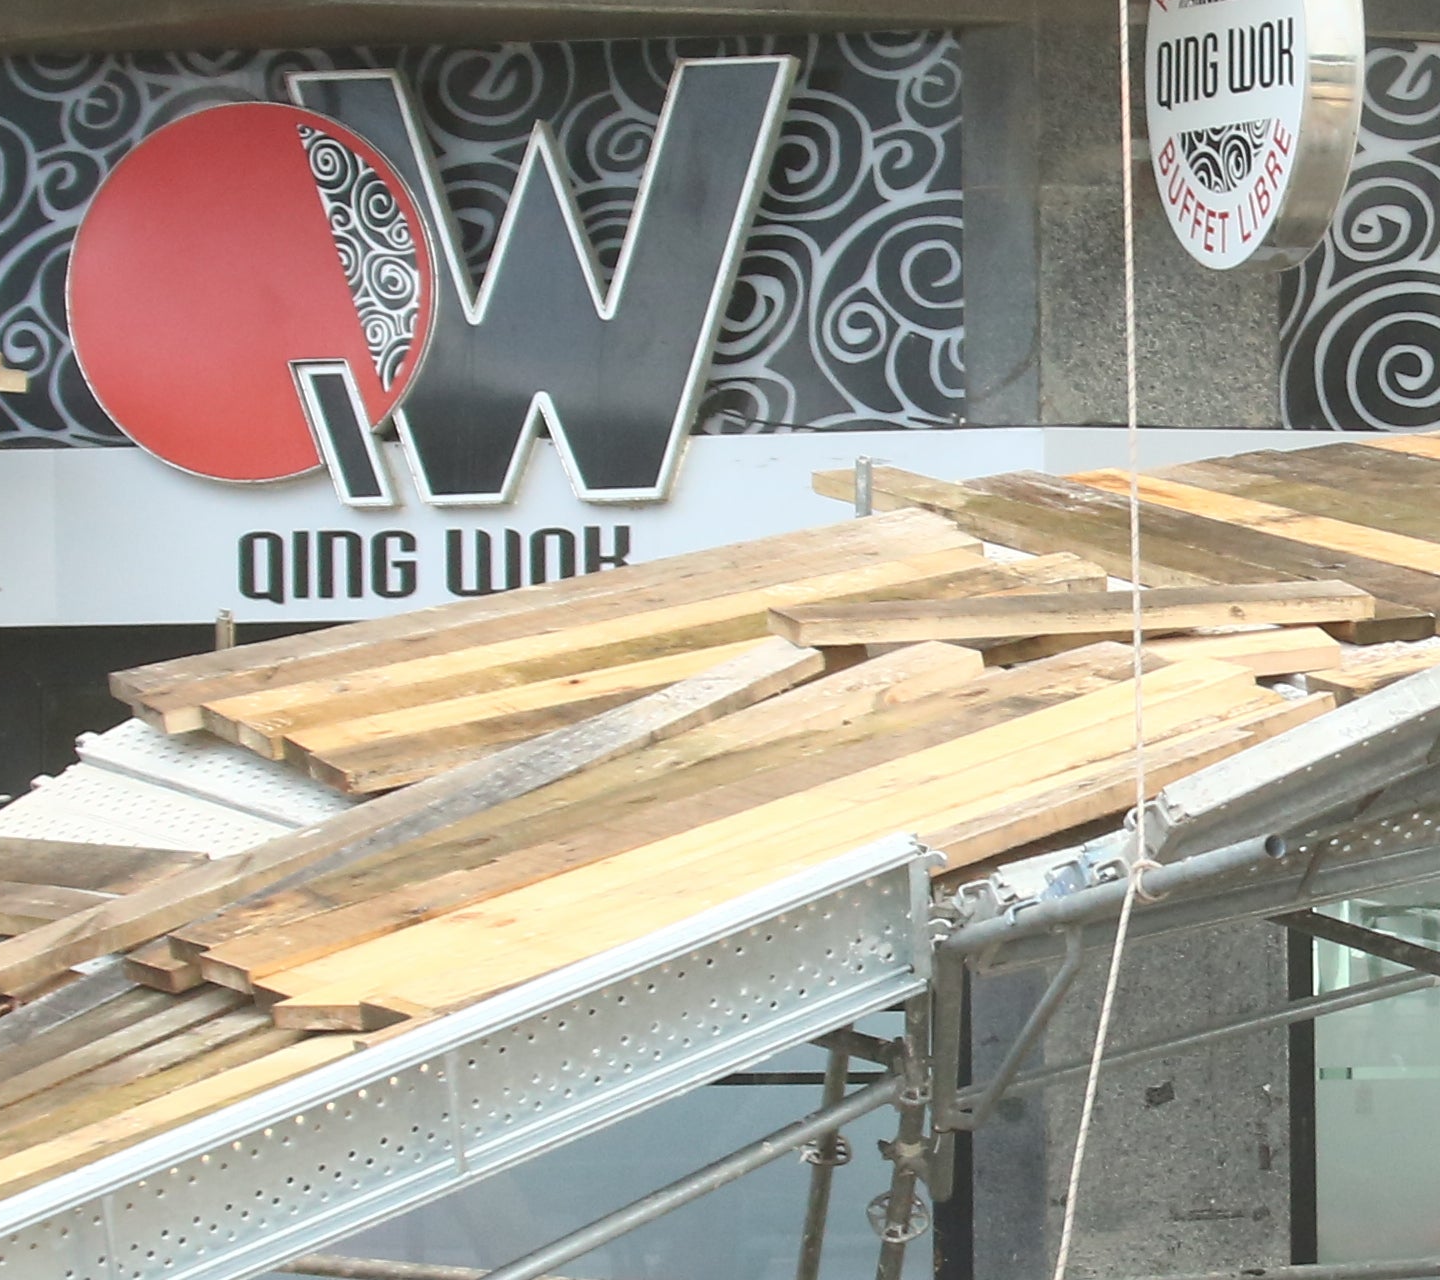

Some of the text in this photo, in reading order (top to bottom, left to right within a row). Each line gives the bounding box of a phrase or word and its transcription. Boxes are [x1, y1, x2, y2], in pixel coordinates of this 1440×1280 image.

[1157, 17, 1295, 111] QING WOK
[1158, 119, 1292, 254] BUFFET LIBRE
[238, 525, 632, 604] QING WOK
